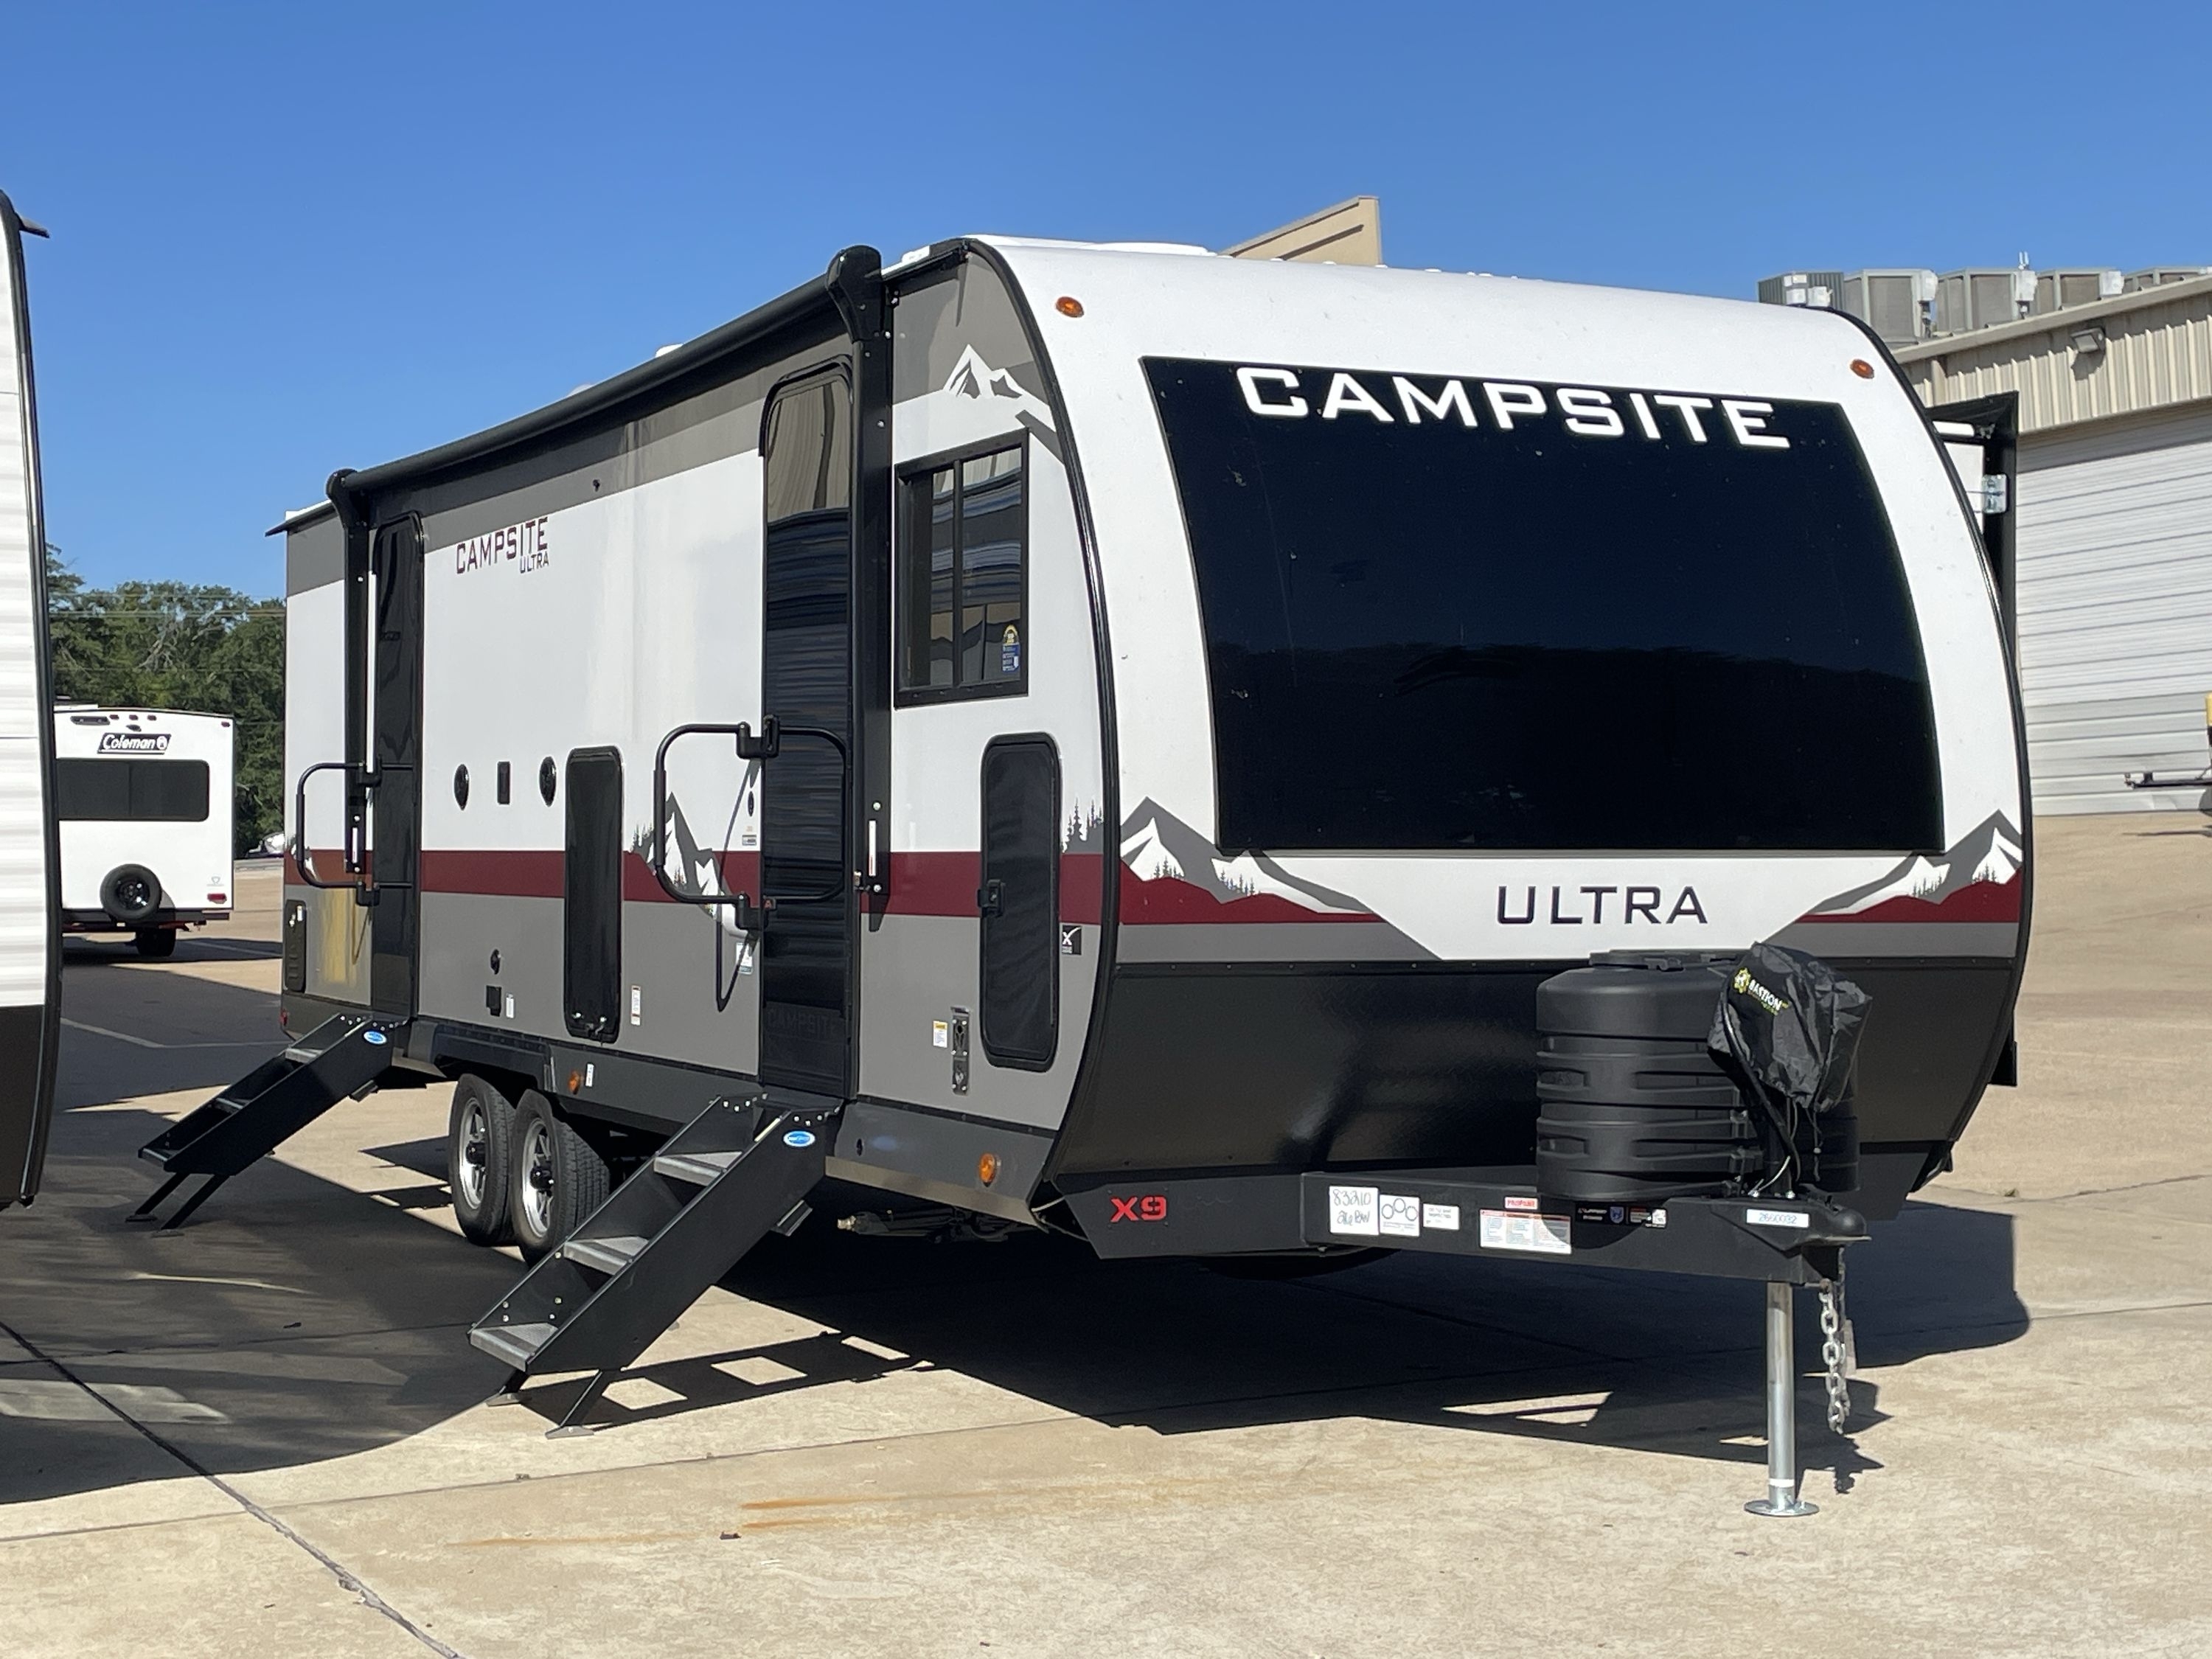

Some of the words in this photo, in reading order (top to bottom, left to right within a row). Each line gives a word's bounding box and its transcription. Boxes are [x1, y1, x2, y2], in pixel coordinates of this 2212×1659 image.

[1237, 367, 1791, 448] CAMPSITE
[456, 516, 548, 574] CAMPSITE
[519, 551, 549, 574] ULTRA
[103, 734, 156, 750] Coleman
[1498, 886, 1708, 924] ULTRA
[1749, 979, 1783, 1011] BASTION
[1110, 1196, 1166, 1222] X9
